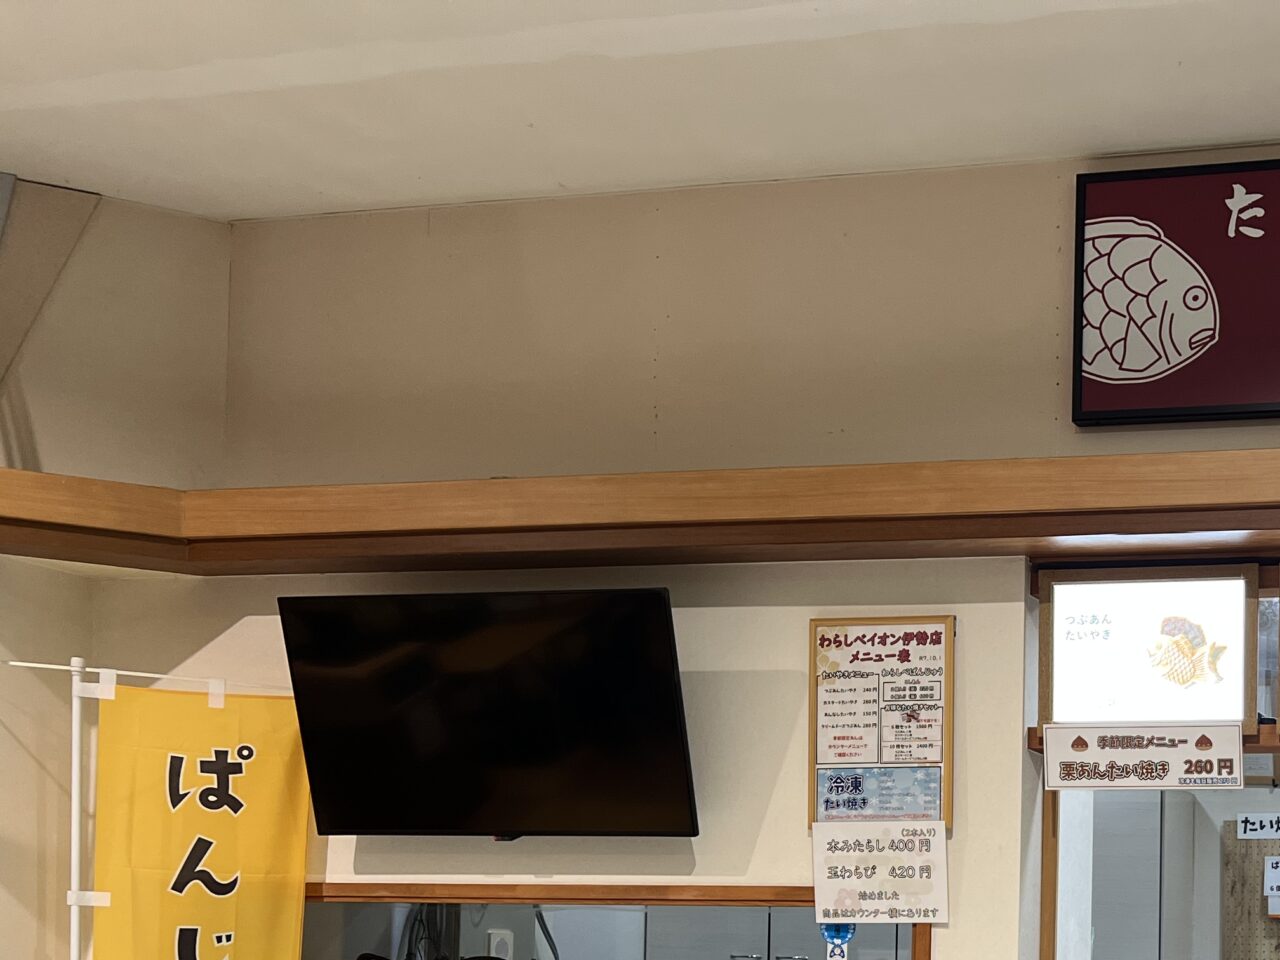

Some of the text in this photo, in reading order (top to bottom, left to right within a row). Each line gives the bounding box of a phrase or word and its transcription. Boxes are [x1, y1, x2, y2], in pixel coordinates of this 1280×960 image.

[1065, 614, 1112, 626] つぶあん
[818, 631, 943, 648] わらしべイオン伊勢店
[1065, 629, 1111, 641] たいやき
[849, 648, 911, 663] メニュー表
[1097, 735, 1188, 750] 季節限定メニュー
[1059, 761, 1170, 781] 栗あんたい焼き
[827, 774, 865, 795] 冷凍
[823, 797, 869, 812] たい焼き
[827, 838, 931, 853] 本みたらし 400円
[888, 866, 932, 879] 420円
[858, 891, 900, 900] 始めました
